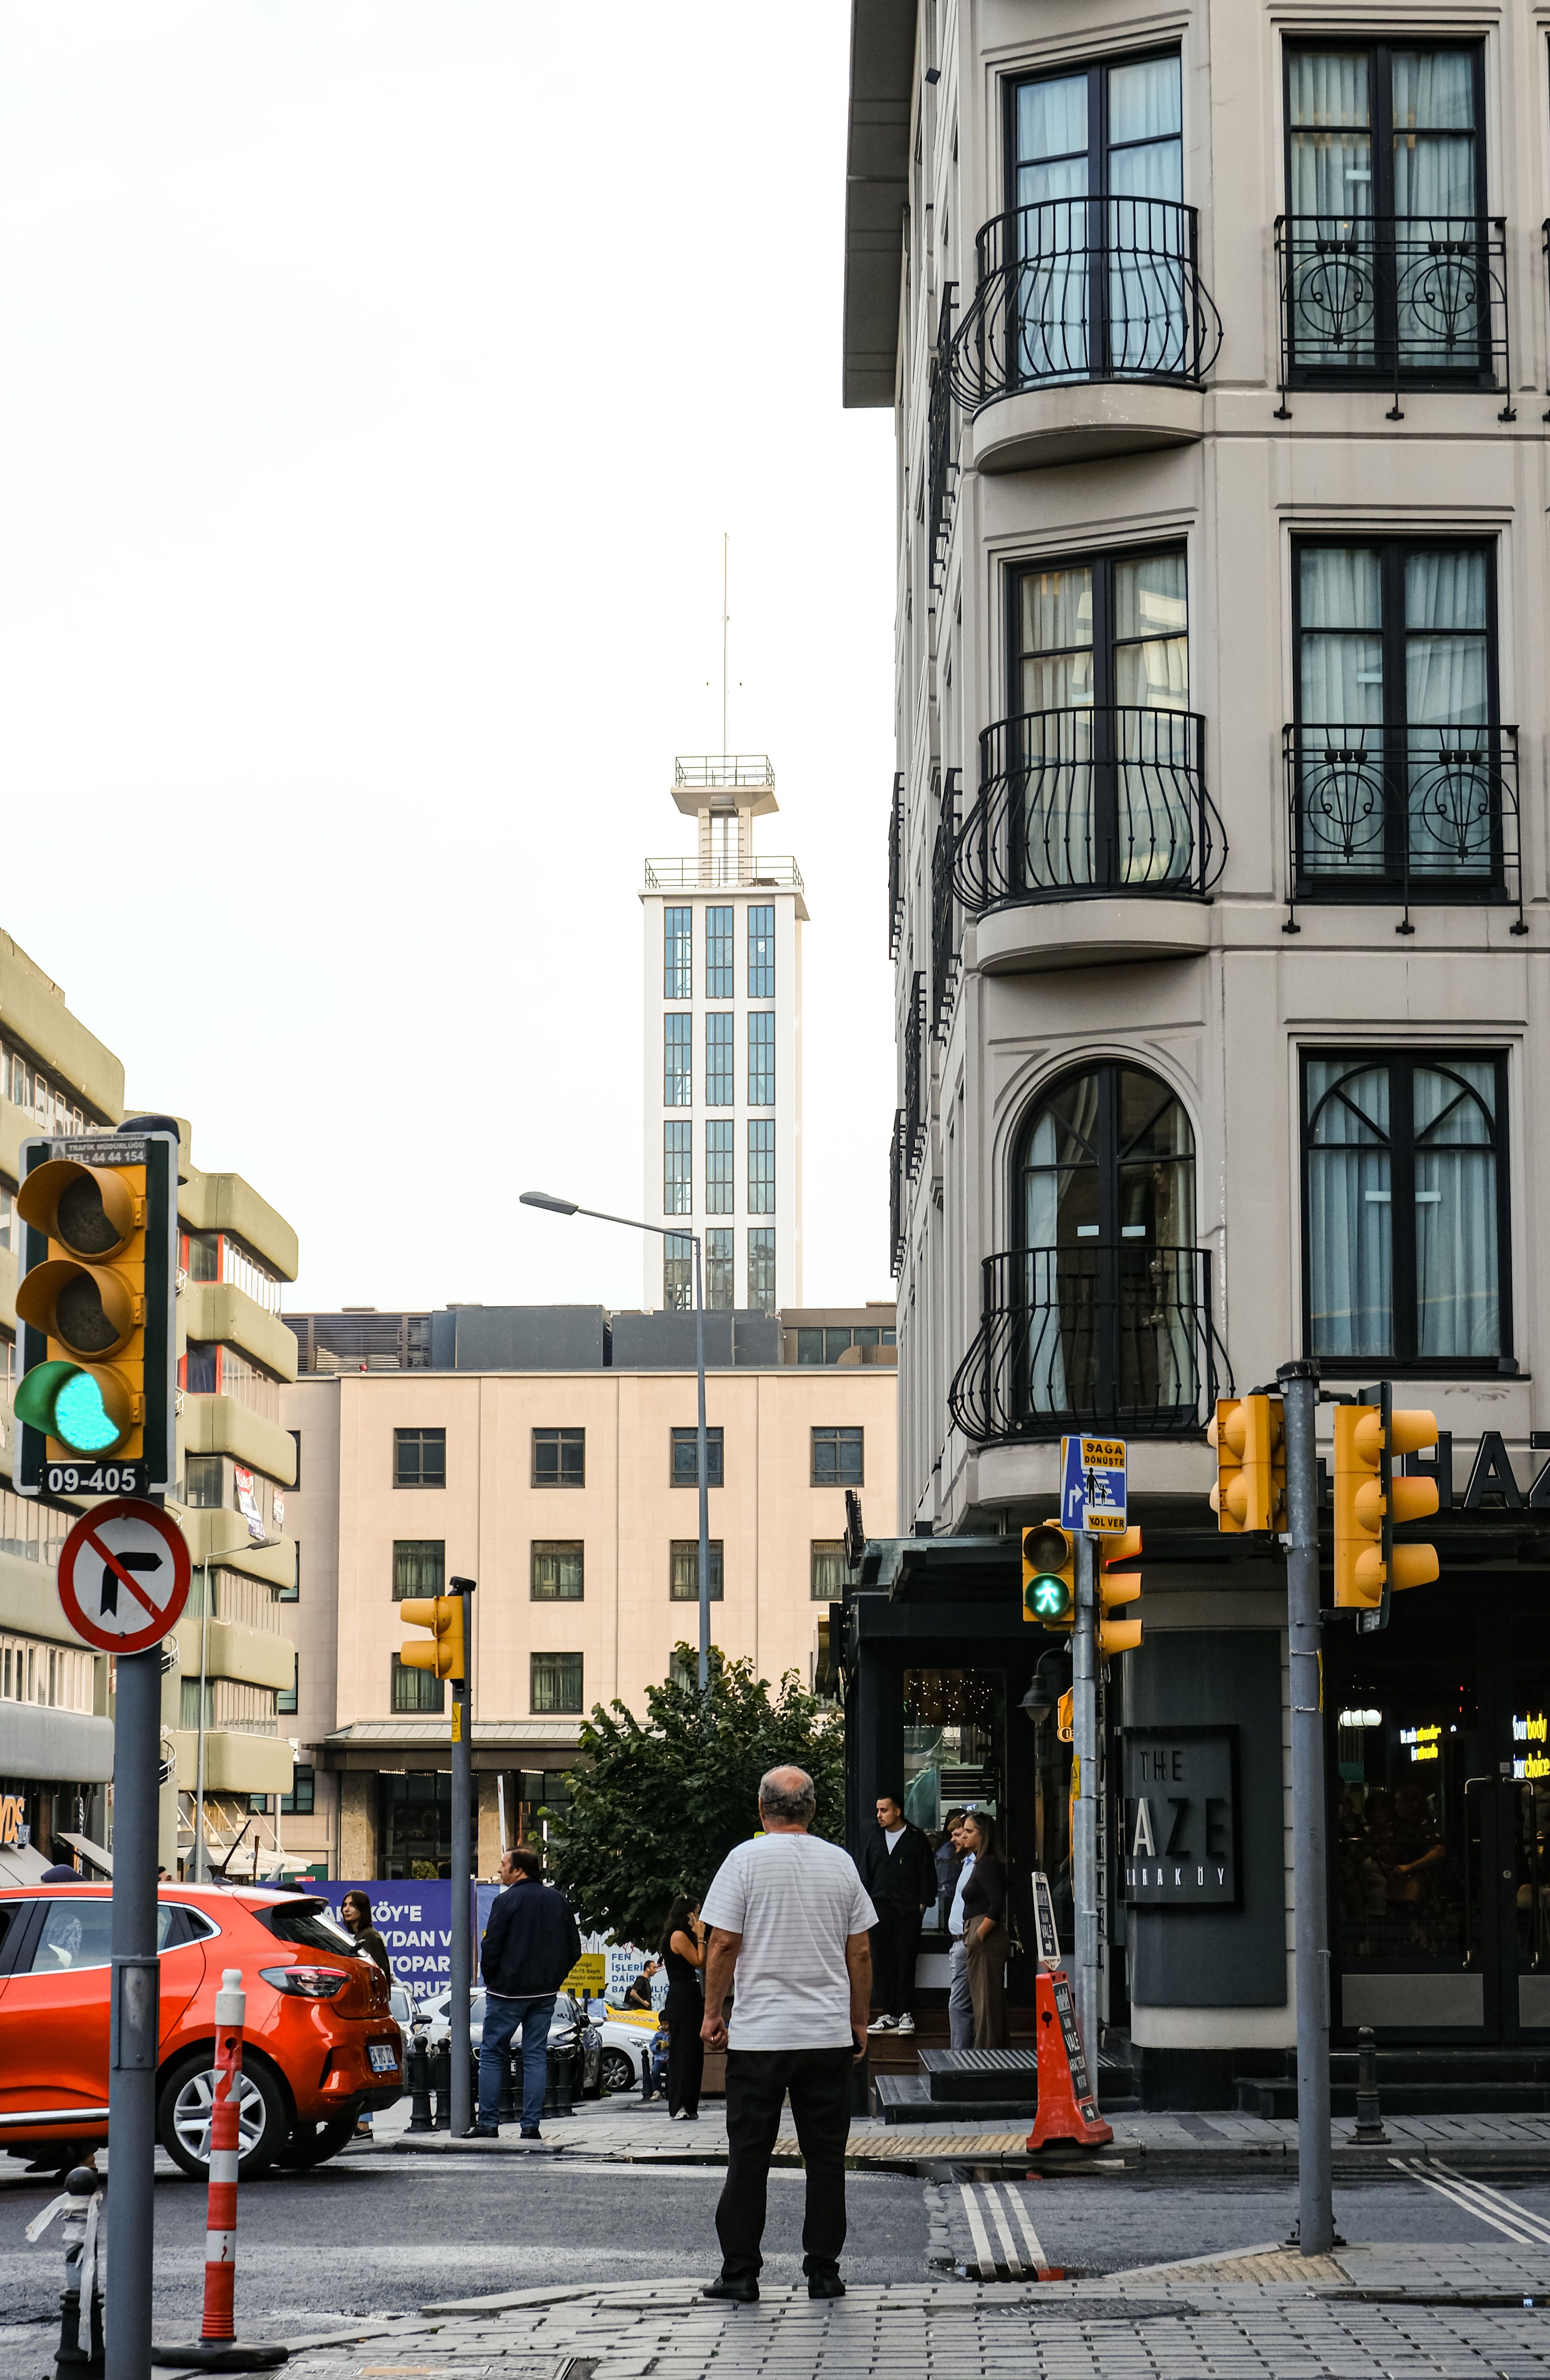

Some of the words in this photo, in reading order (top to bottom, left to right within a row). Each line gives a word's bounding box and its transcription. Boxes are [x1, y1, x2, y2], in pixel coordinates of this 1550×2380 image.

[69, 1143, 95, 1151] TRAFİK
[96, 1141, 145, 1151] MÜDÜRLÜĞÜ
[66, 1153, 90, 1163] TEL:
[92, 1153, 105, 1162] 44
[108, 1152, 121, 1162] 44
[124, 1151, 144, 1161] 154
[1086, 1442, 1123, 1455] SAĞA
[1085, 1455, 1124, 1467] DÖNÜŞTE
[48, 1468, 136, 1492] 09-405
[1089, 1517, 1105, 1526] YOL
[1108, 1518, 1124, 1528] VER
[1140, 1750, 1183, 1782] THE
[1117, 1797, 1225, 1857] HAZE
[612, 1962, 643, 1973] İŞLERİ
[1064, 2031, 1080, 2052] VALE
